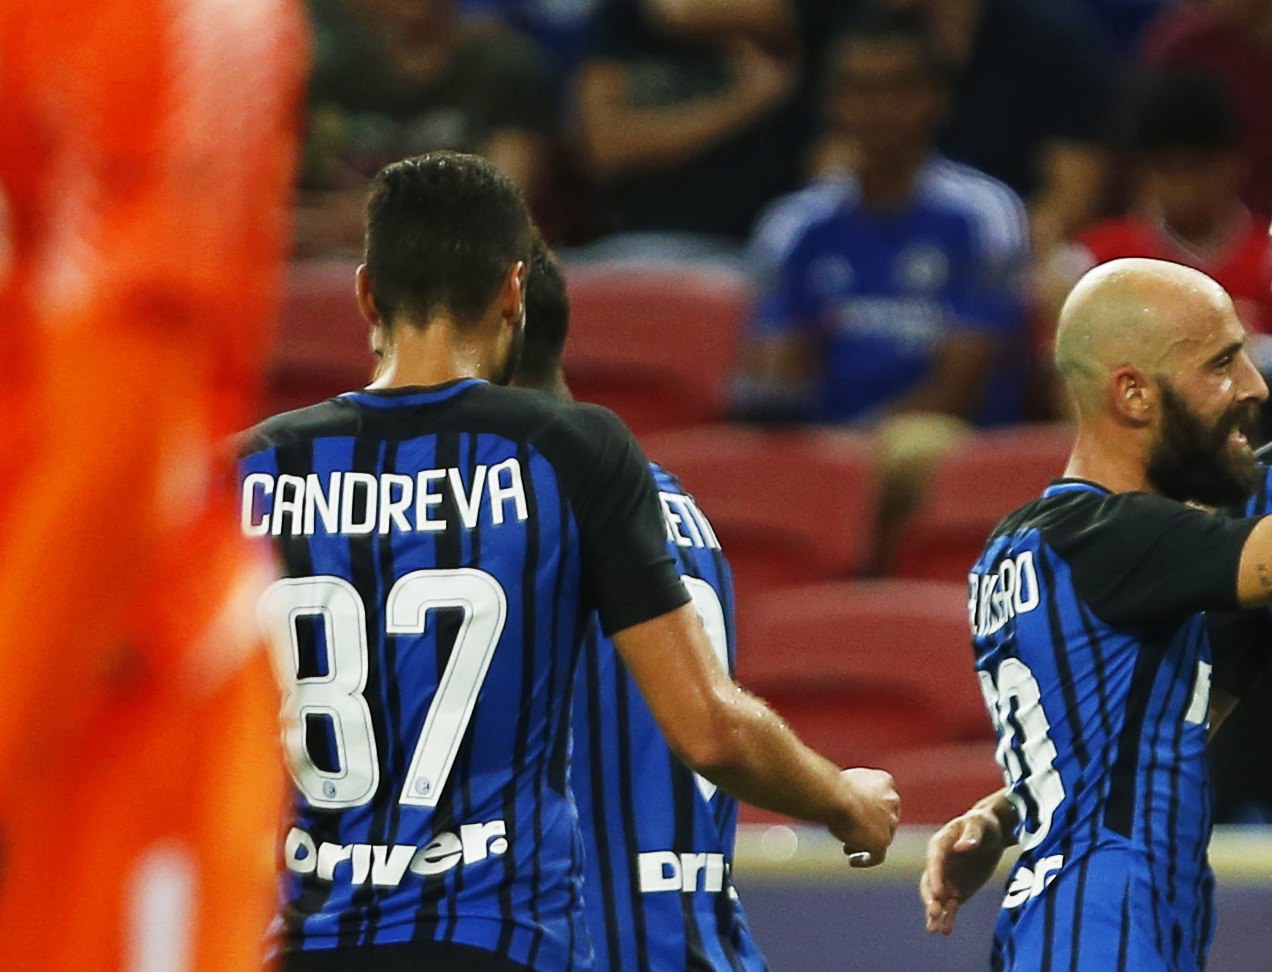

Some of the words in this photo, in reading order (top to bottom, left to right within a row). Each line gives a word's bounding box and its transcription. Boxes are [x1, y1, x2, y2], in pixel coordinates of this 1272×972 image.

[241, 457, 528, 536] CANDREVA
[260, 568, 507, 809] 87
[978, 657, 1066, 851] 0
[637, 850, 731, 894] Dri
